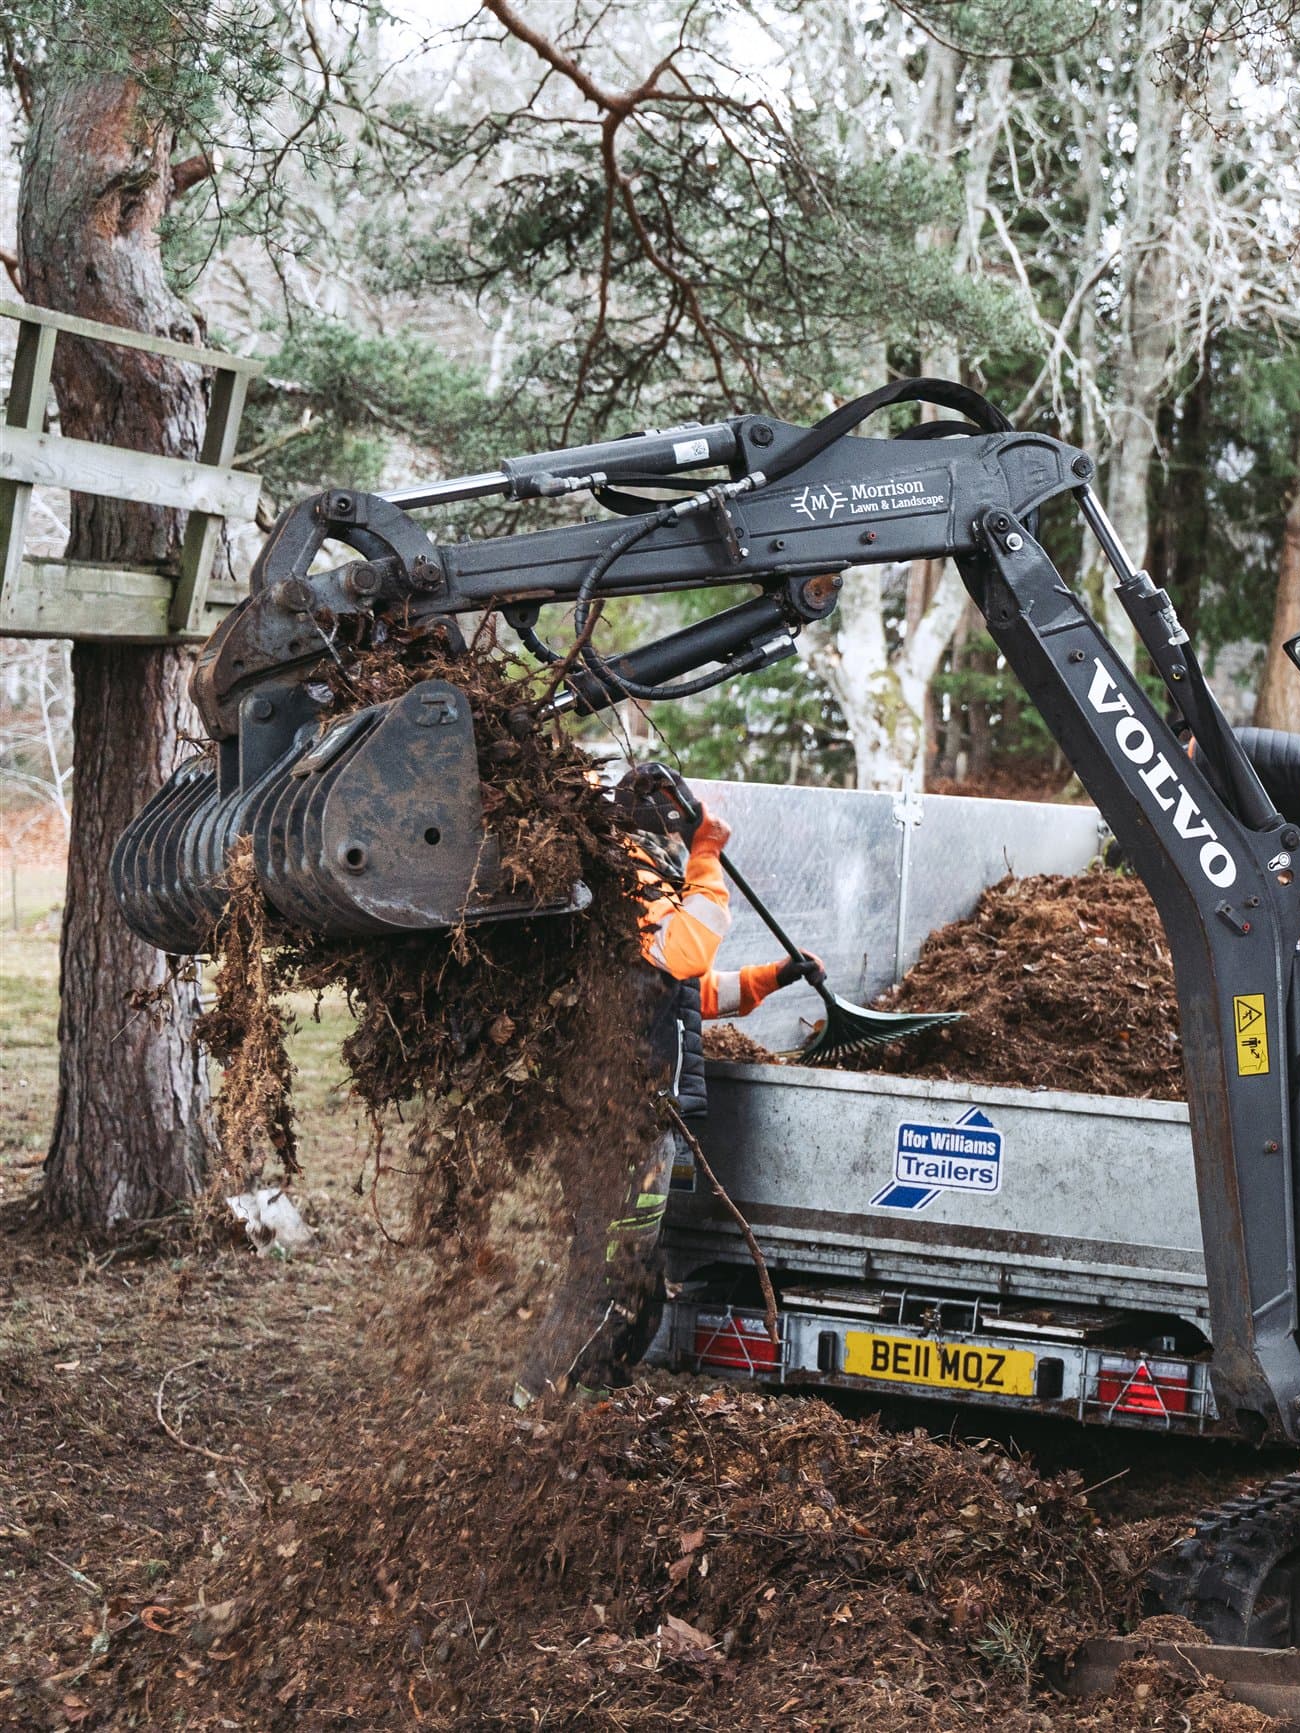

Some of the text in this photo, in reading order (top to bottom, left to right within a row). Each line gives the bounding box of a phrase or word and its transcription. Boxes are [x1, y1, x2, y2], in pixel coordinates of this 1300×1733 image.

[810, 494, 829, 511] M
[851, 480, 925, 500] Morrison
[850, 494, 944, 514] Lawn & Landscape
[1087, 657, 1237, 888] VOLVO
[902, 1129, 996, 1156] Ifor Williams
[902, 1155, 993, 1184] Trailers
[871, 1340, 931, 1378] BE11
